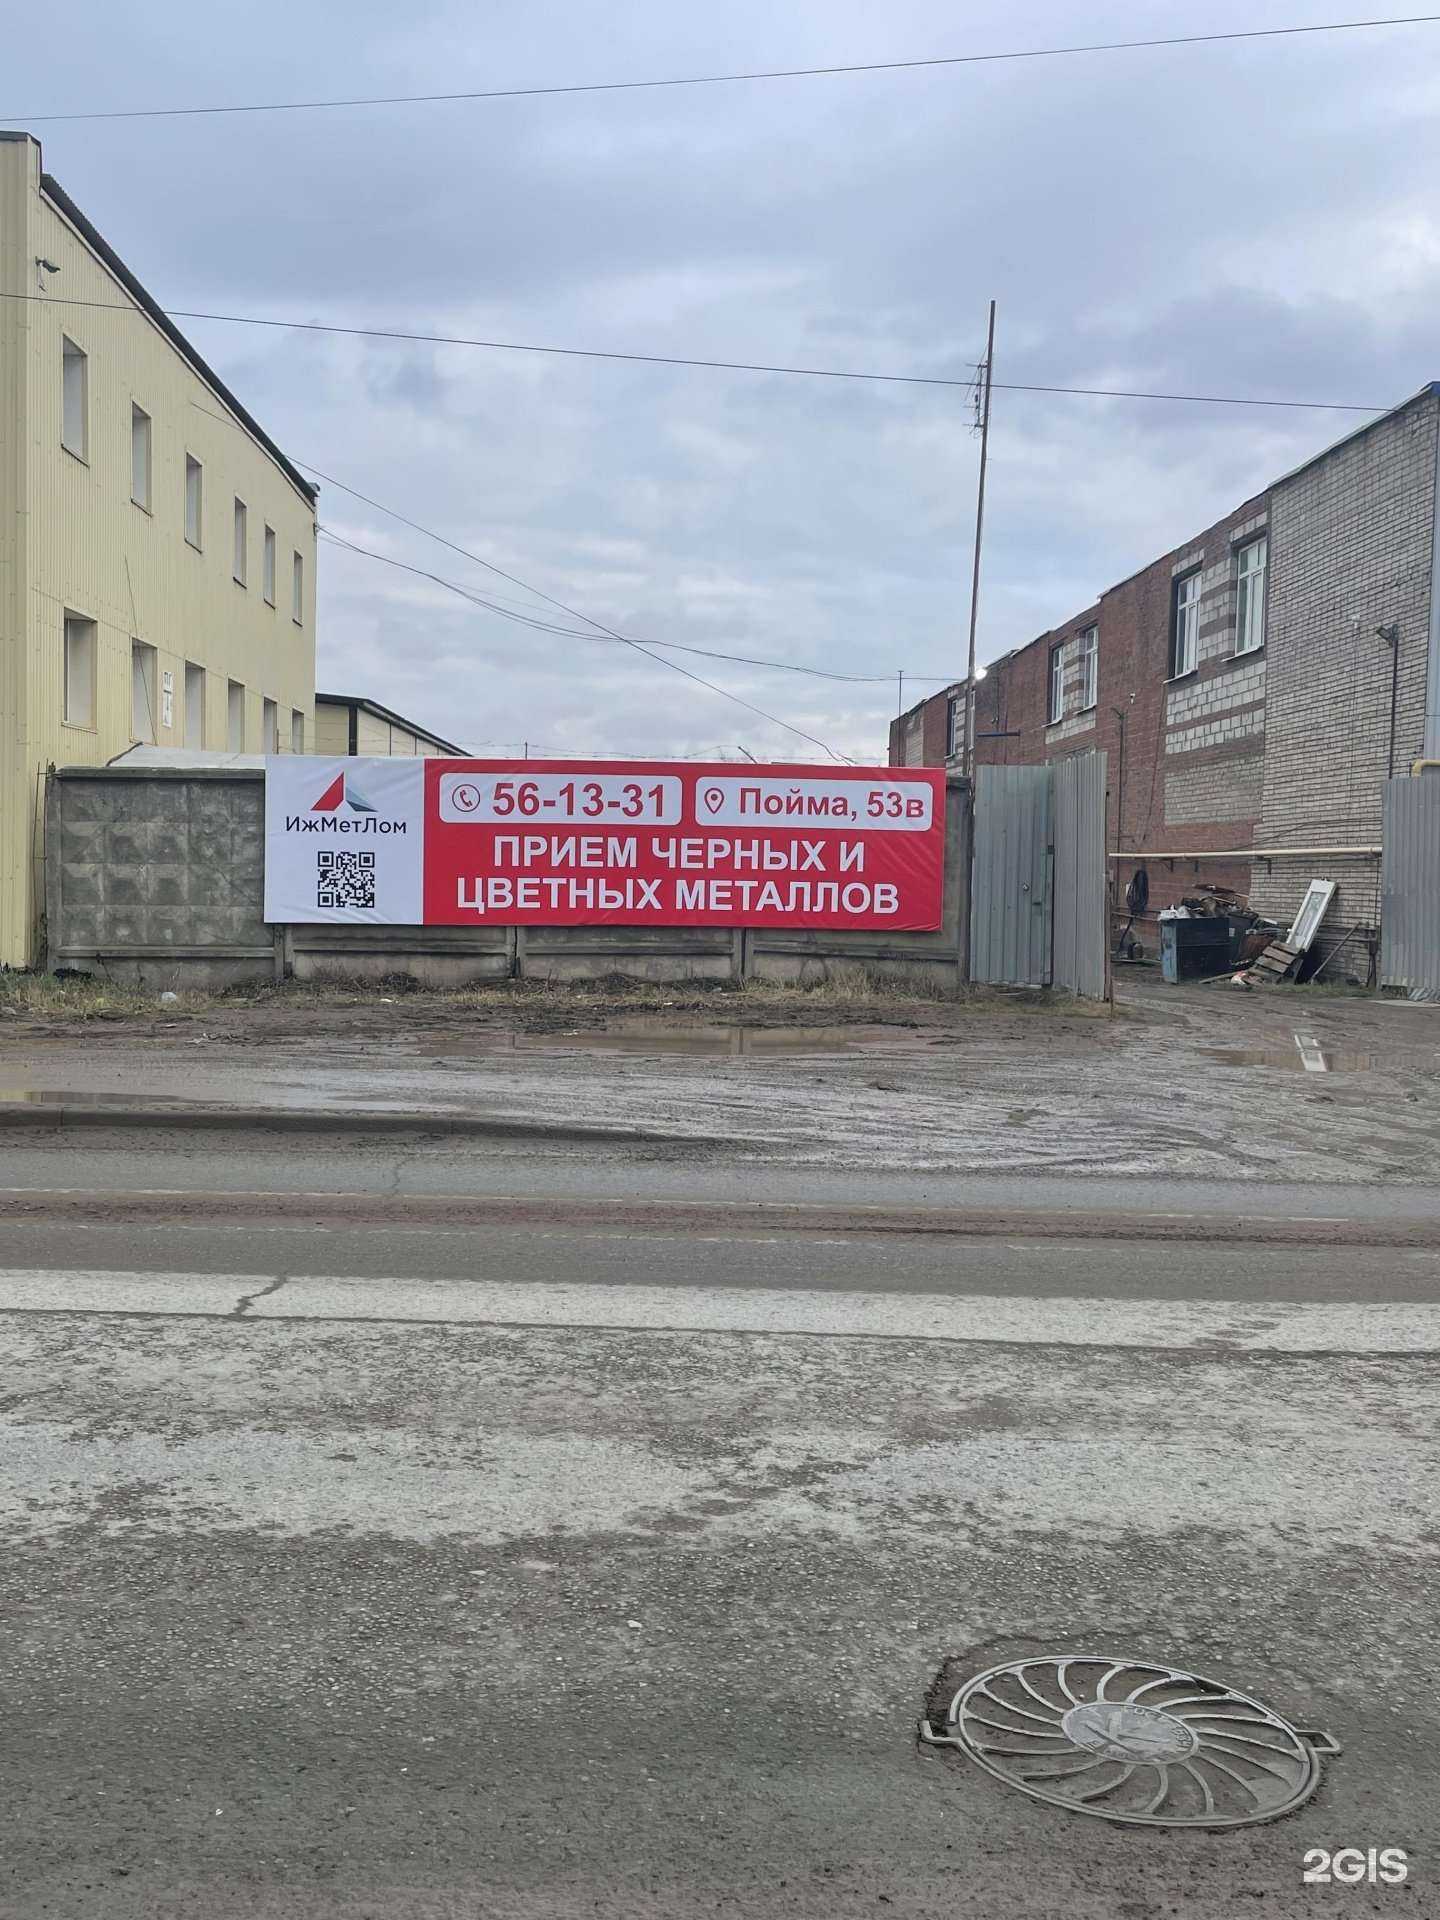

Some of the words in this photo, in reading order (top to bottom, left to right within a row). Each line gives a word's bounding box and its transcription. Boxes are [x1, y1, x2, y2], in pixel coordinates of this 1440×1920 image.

[492, 782, 665, 818] 56-13-31
[739, 787, 857, 822] Пойма,
[866, 791, 924, 818] 53в
[286, 816, 407, 834] ИжМетЛом
[494, 835, 638, 868] ПРИЕМ
[652, 837, 826, 872] ЧЕРНЫХ
[839, 841, 865, 873] И
[456, 877, 663, 915] ЦВЕТНЫХ
[676, 880, 900, 915] МЕТАЛЛОВ
